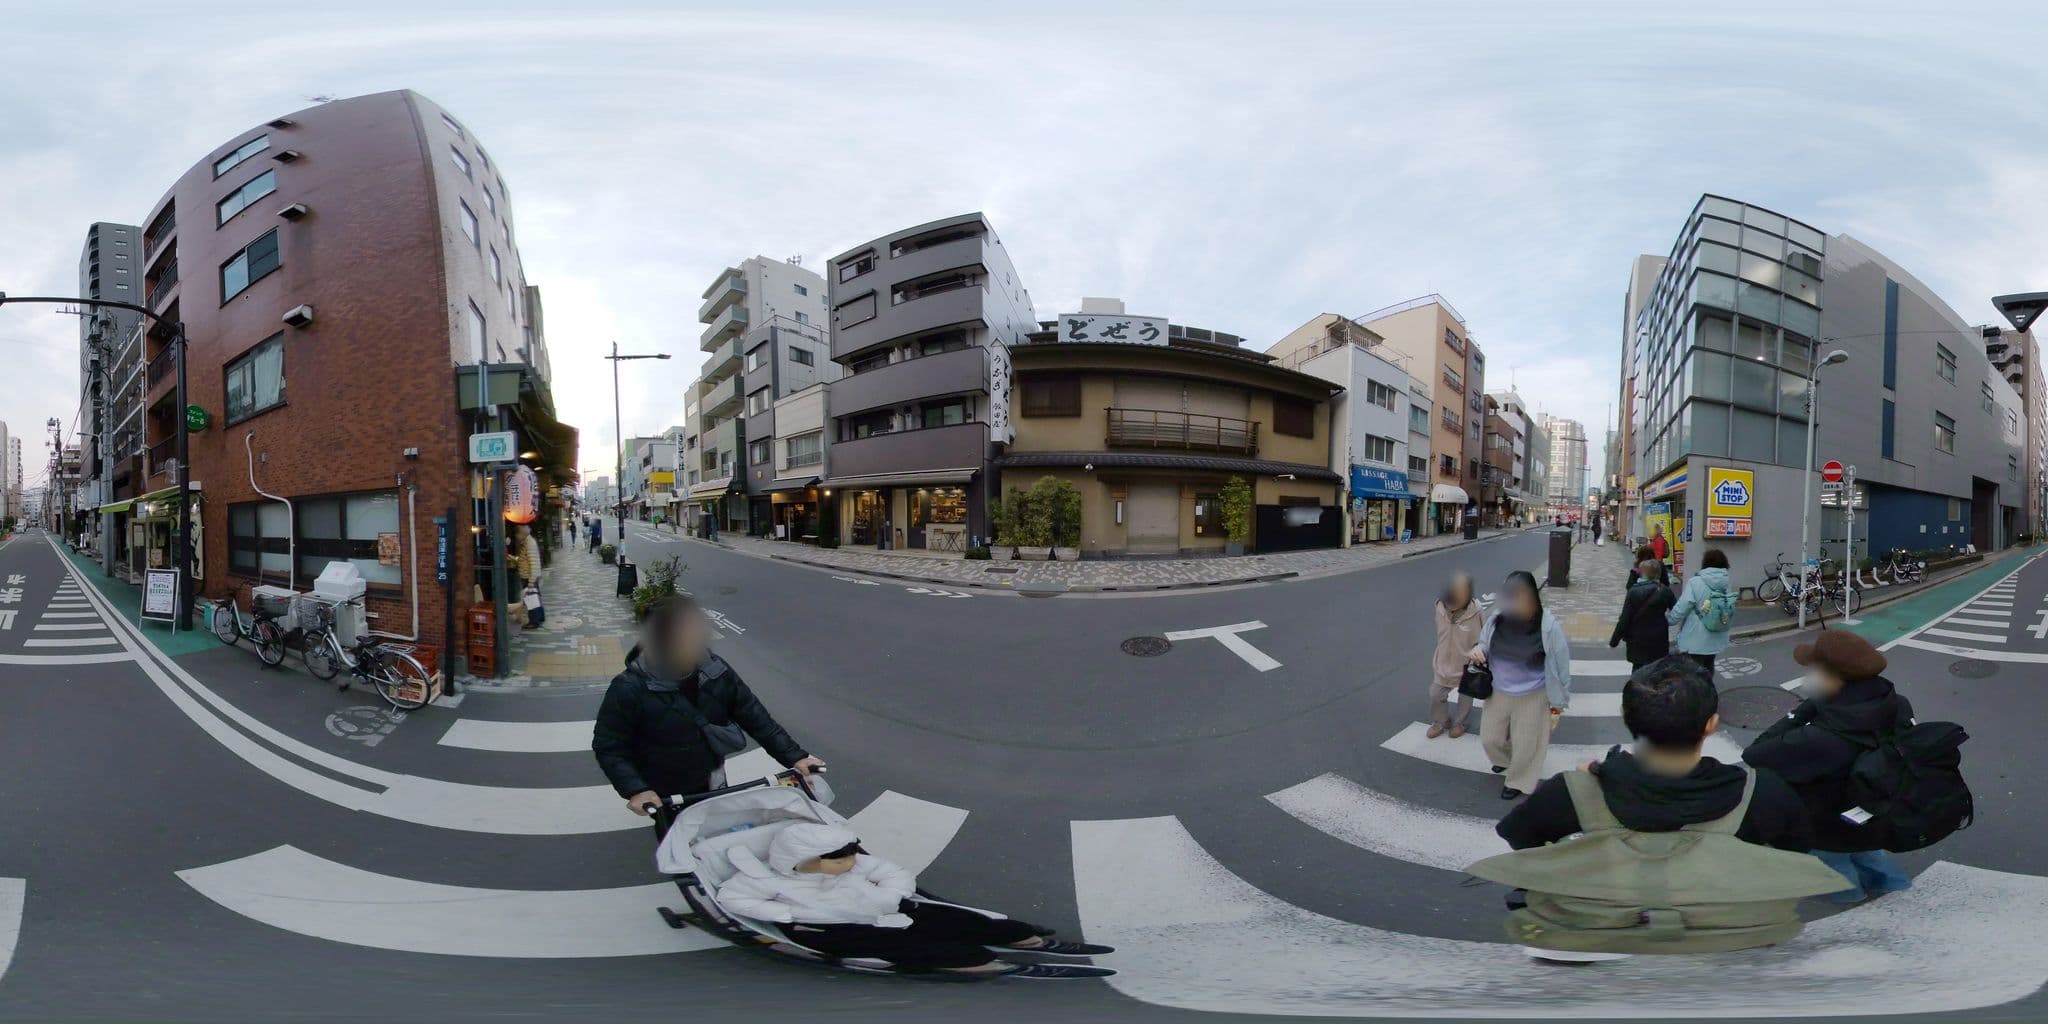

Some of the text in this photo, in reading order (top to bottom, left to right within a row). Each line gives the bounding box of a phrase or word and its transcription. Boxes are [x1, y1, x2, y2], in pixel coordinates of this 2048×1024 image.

[1067, 317, 1160, 341] どぜう
[1384, 479, 1404, 491] HABA
[1723, 486, 1743, 494] MINI
[1721, 494, 1743, 502] STOP
[1735, 523, 1751, 533] ATM
